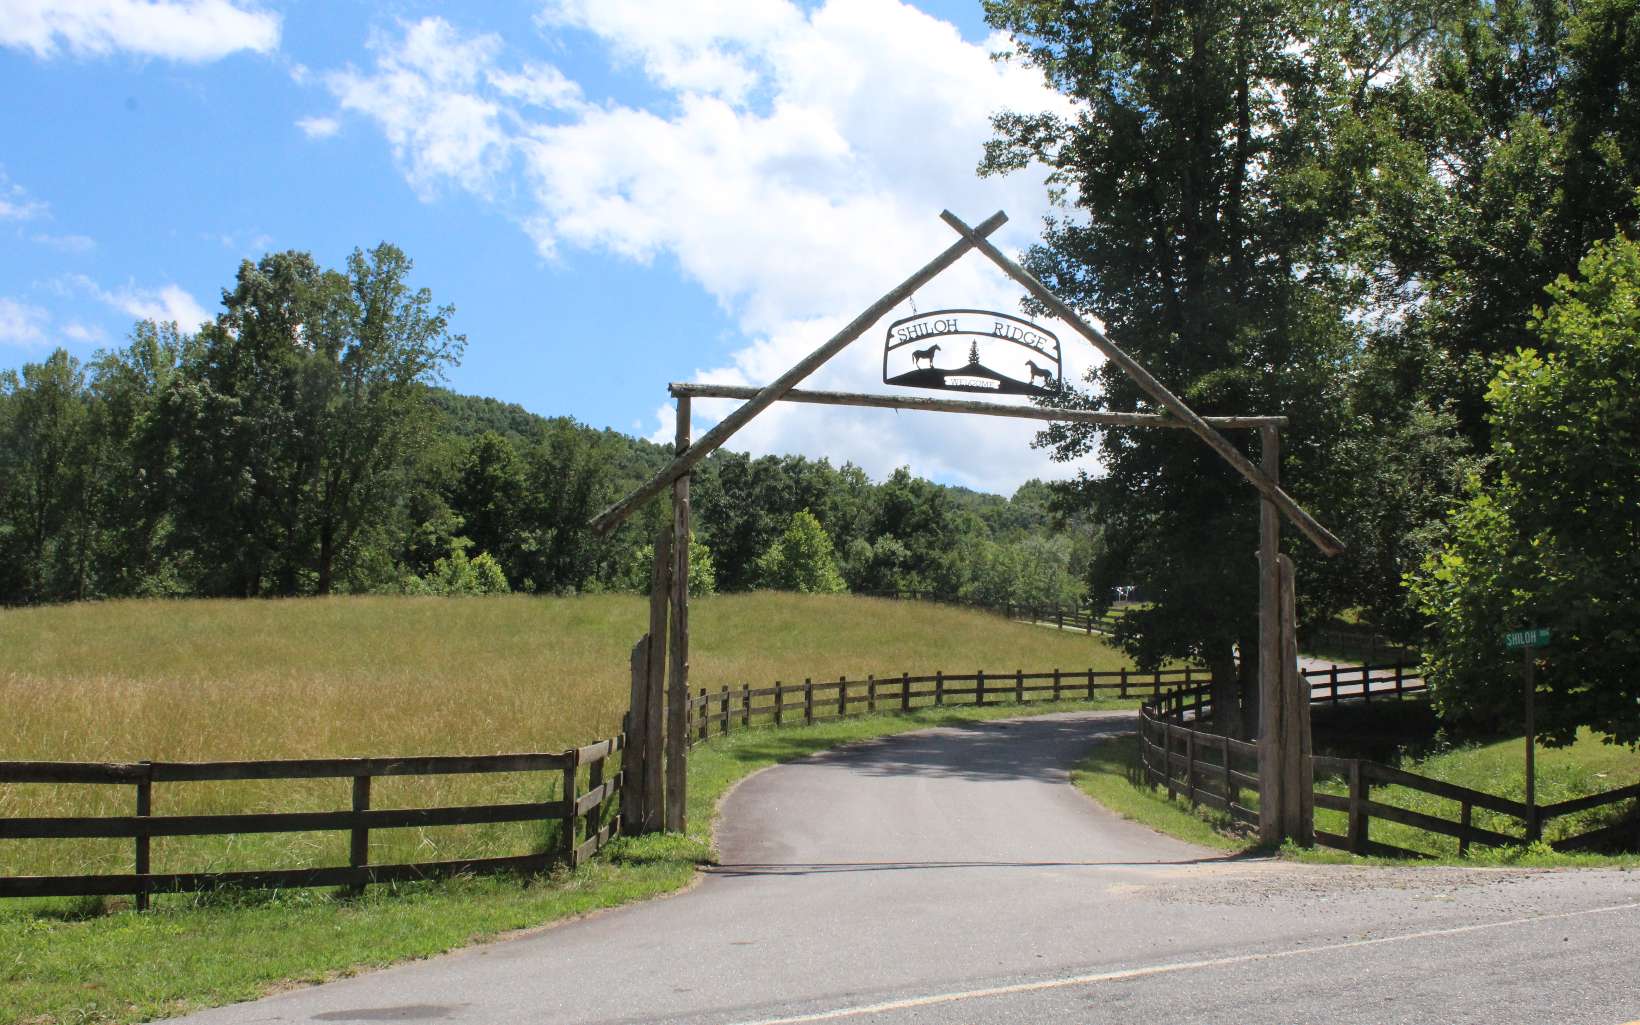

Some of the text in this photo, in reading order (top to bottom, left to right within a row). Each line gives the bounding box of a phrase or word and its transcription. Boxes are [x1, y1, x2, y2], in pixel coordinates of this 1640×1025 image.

[897, 319, 1048, 350] SHILOH RIDGE
[1506, 631, 1537, 646] SHILOH
